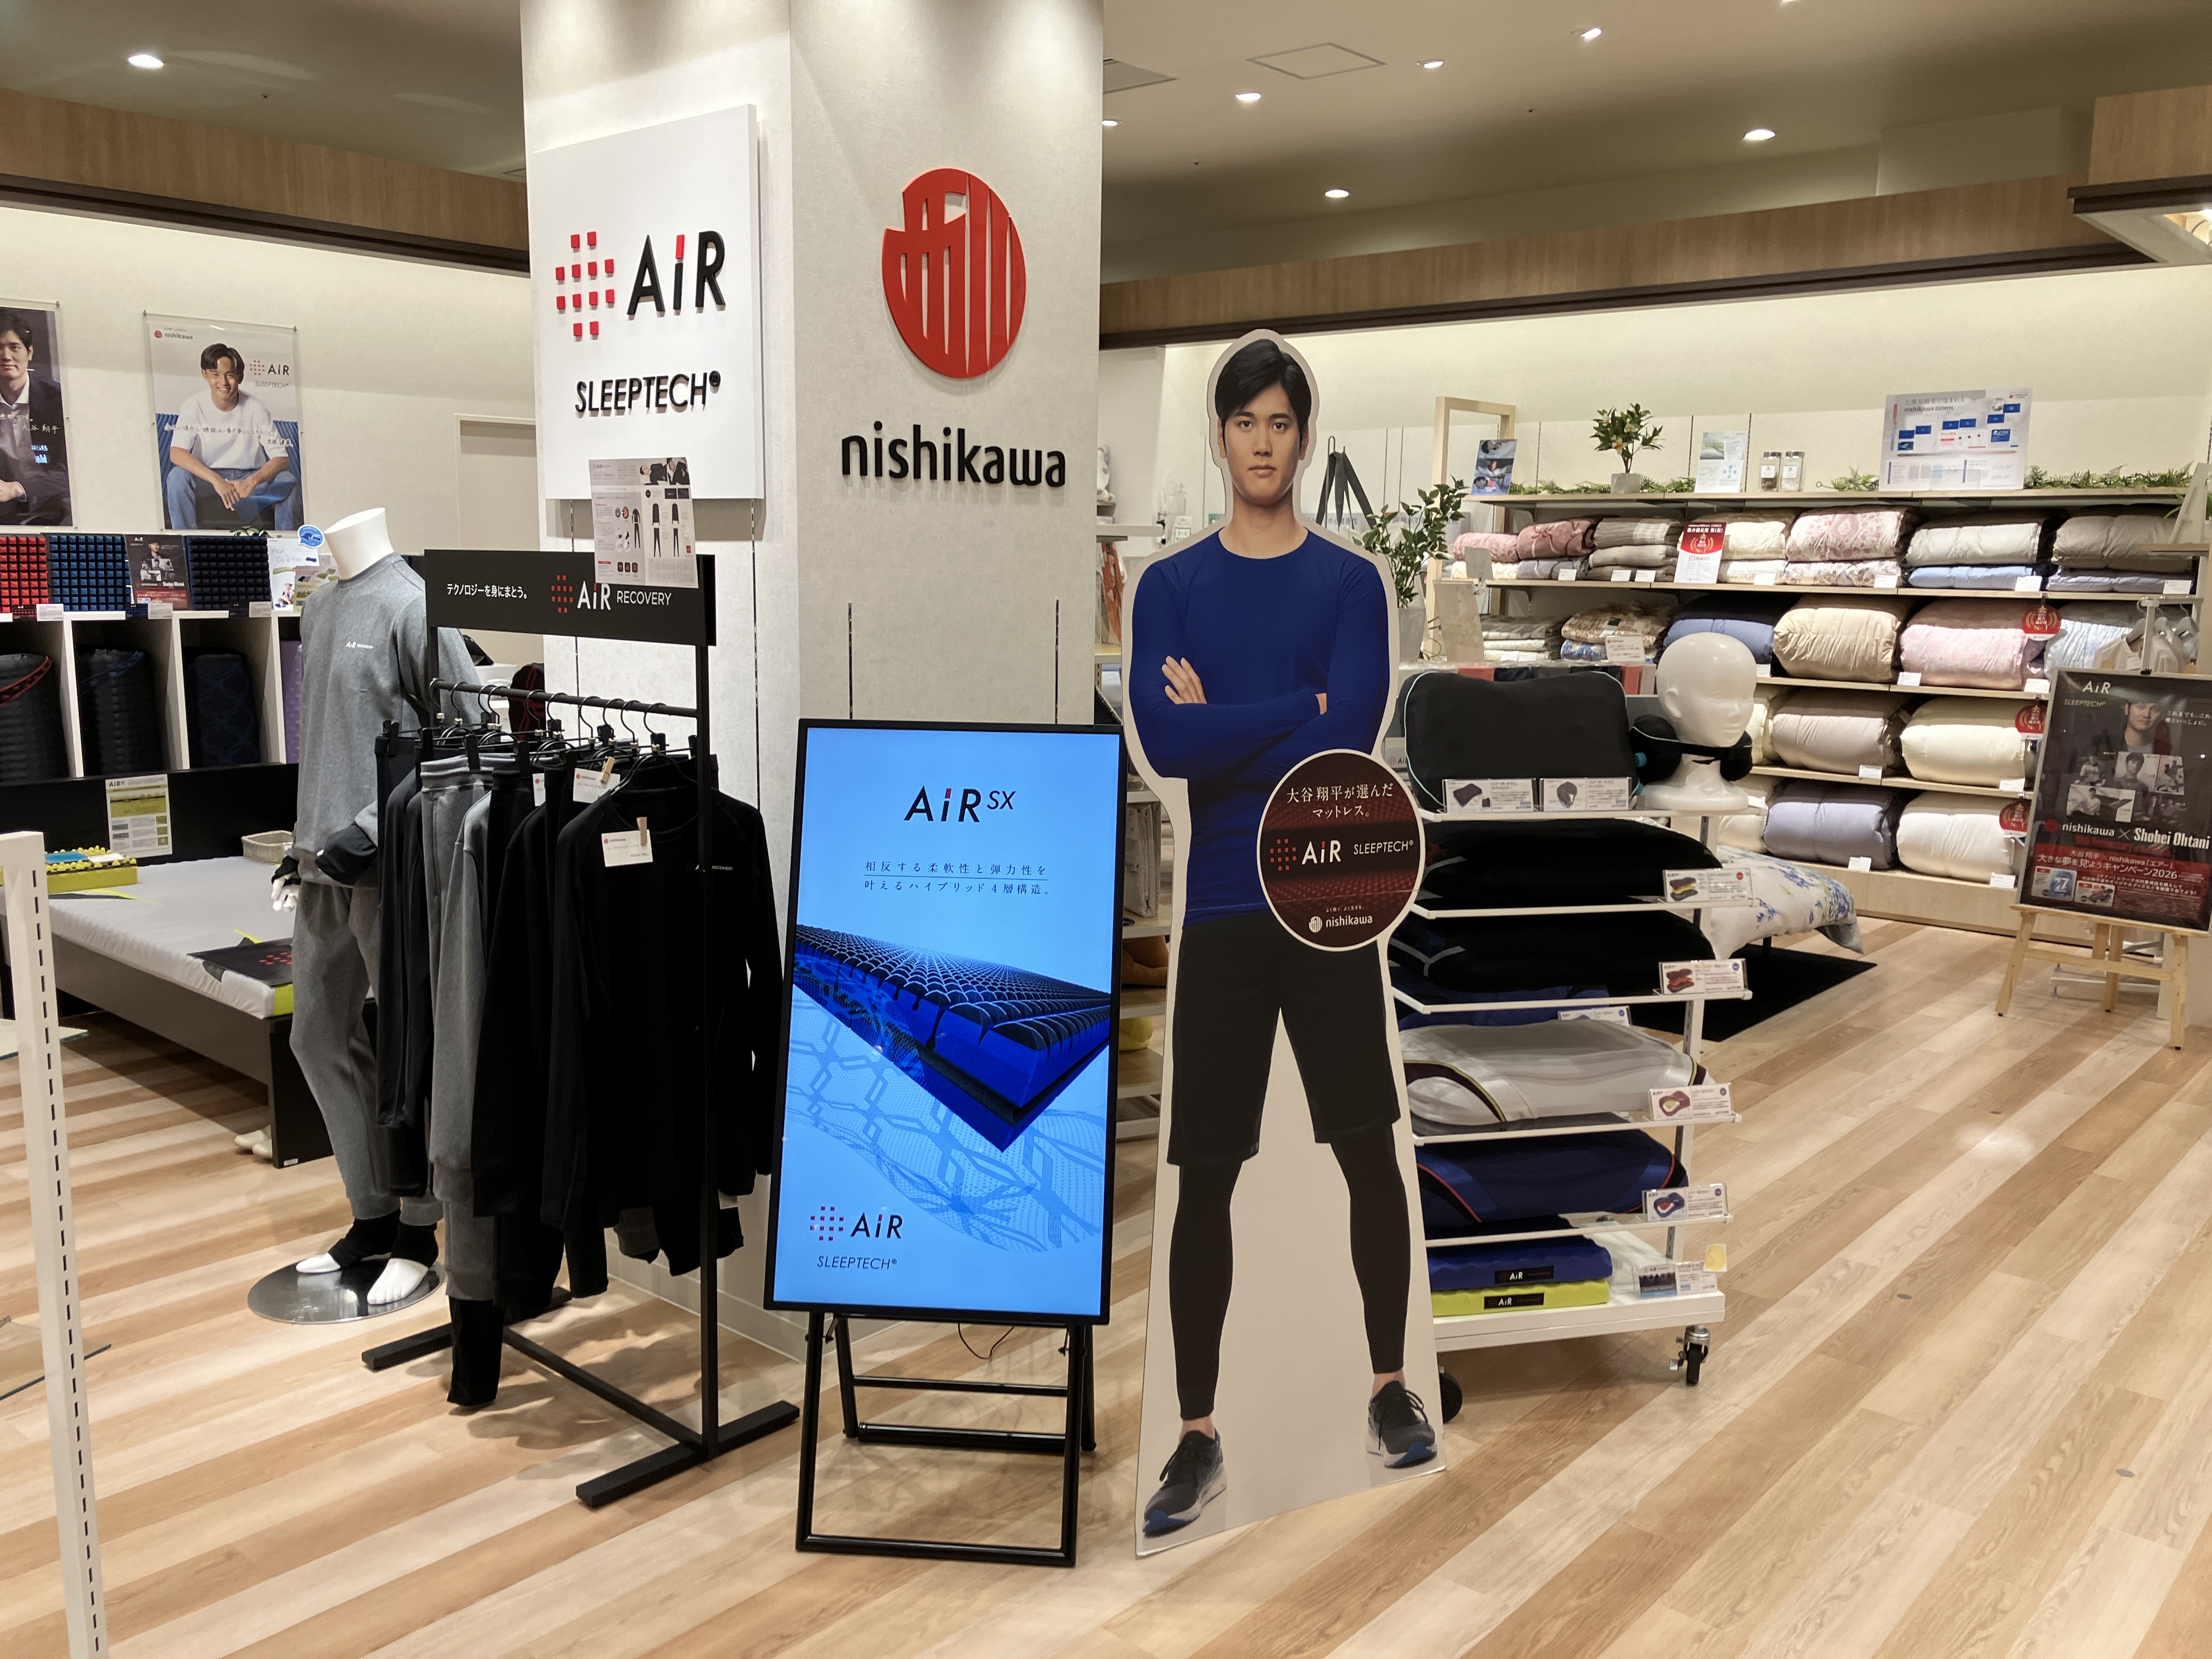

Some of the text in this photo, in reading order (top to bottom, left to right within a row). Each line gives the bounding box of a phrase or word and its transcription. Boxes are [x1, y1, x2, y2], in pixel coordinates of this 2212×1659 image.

[842, 420, 1066, 487] nishikawa
[447, 583, 527, 599] テクノロジーを身にまとう。
[617, 590, 672, 606] RECOVERY
[987, 790, 1016, 810] SX
[1286, 782, 1394, 804] 大谷翔平が選んだ
[1312, 805, 1369, 819] マットレス。
[2062, 824, 2115, 837] nishikawa
[2134, 827, 2171, 845] Shohei
[2173, 832, 2210, 850] Ohtani
[865, 860, 1046, 876] 相反する柔軟性と弾力性を
[865, 880, 1048, 895] 叶えるハイブリッド4層構造。
[1325, 915, 1373, 928] nishikawa
